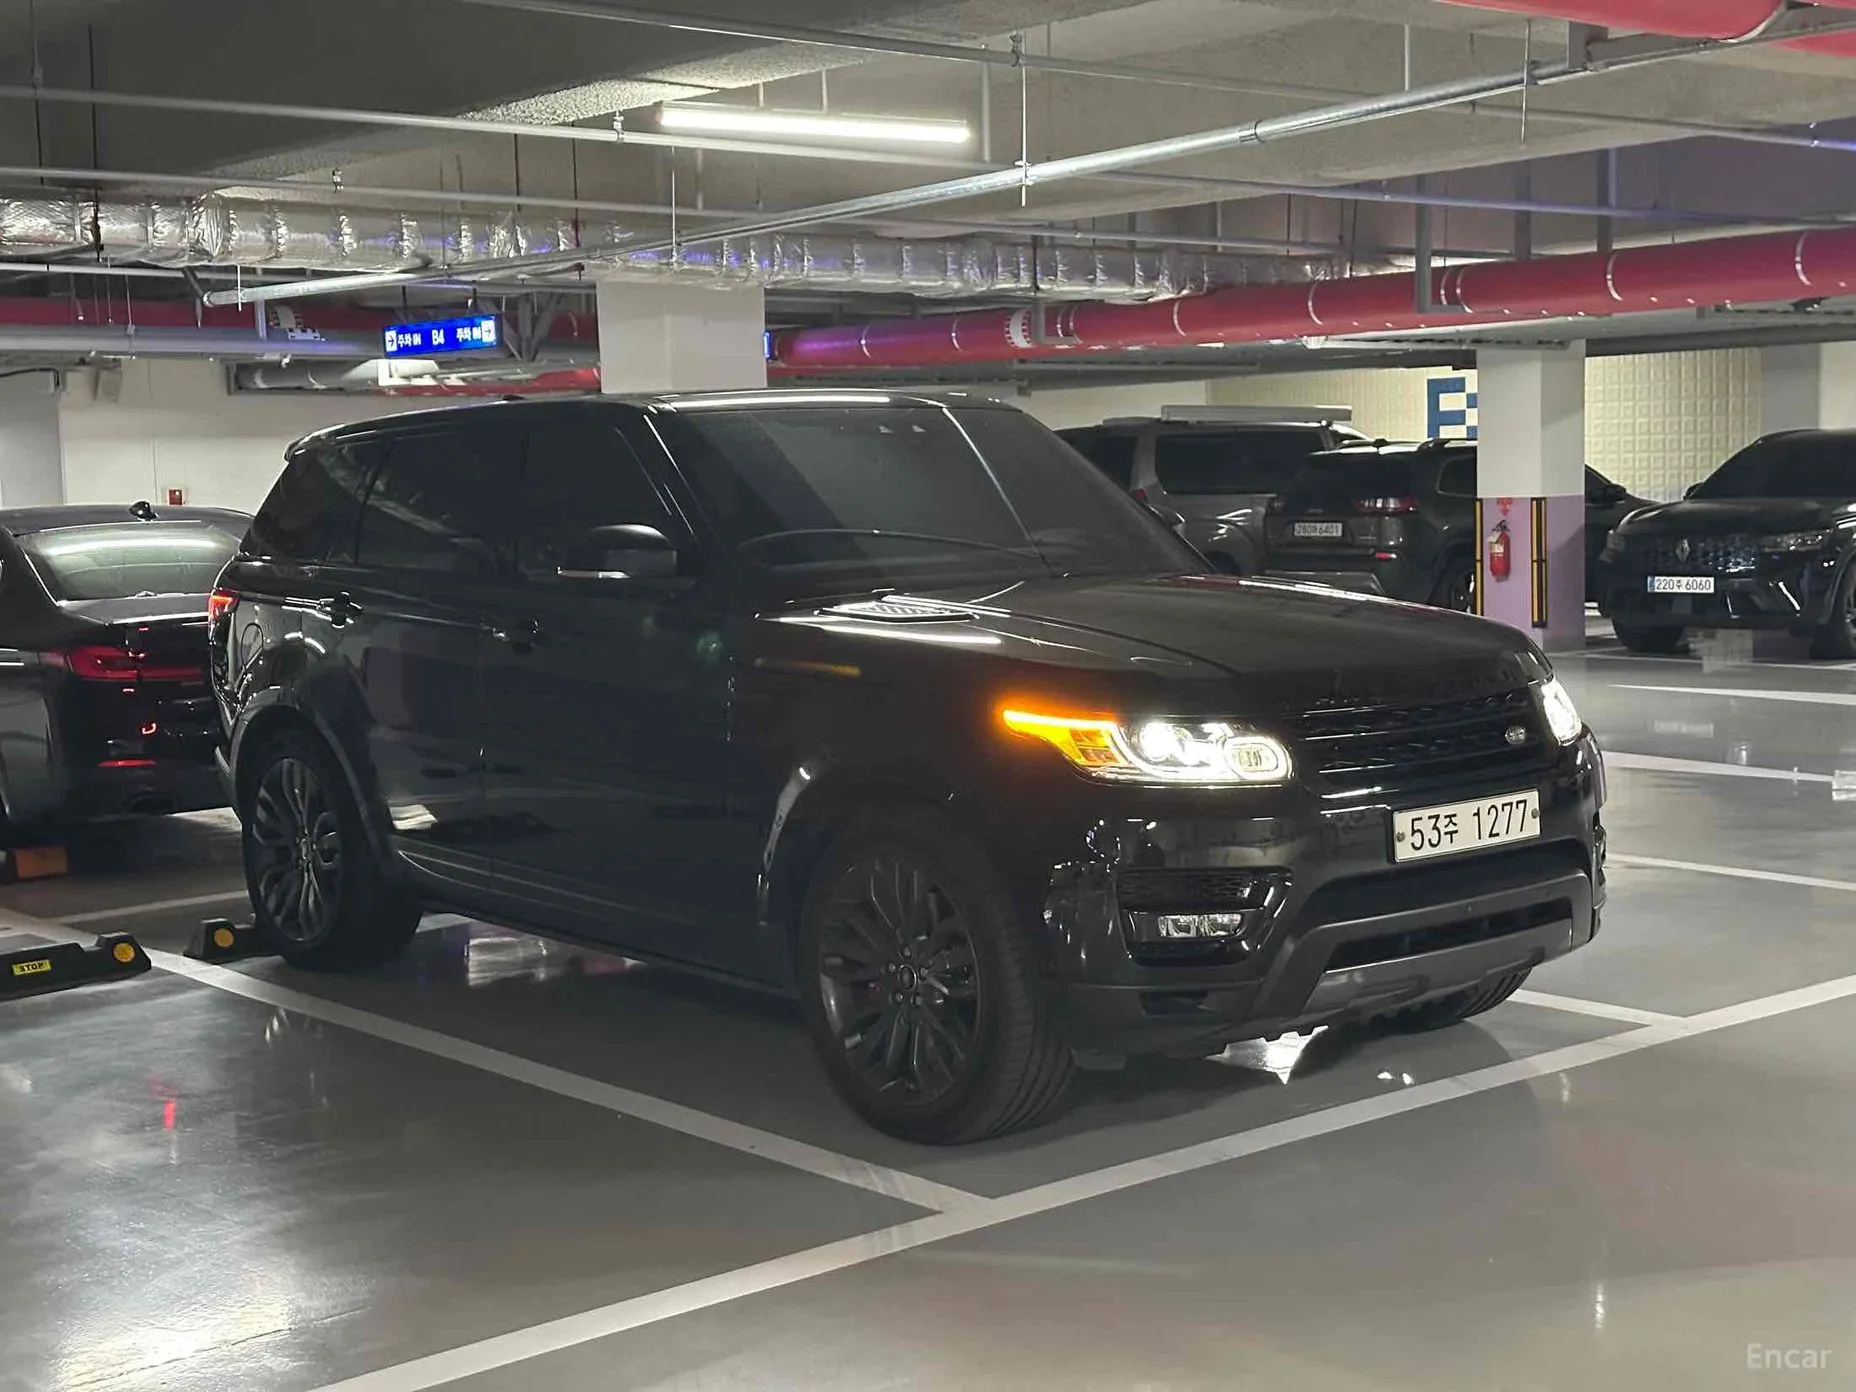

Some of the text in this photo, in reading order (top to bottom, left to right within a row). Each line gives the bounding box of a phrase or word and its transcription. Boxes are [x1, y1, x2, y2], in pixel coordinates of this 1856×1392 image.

[431, 328, 445, 345] B4
[1685, 579, 1711, 591] 6060
[1410, 799, 1527, 851] 53주 1277
[19, 962, 44, 972] STOP
